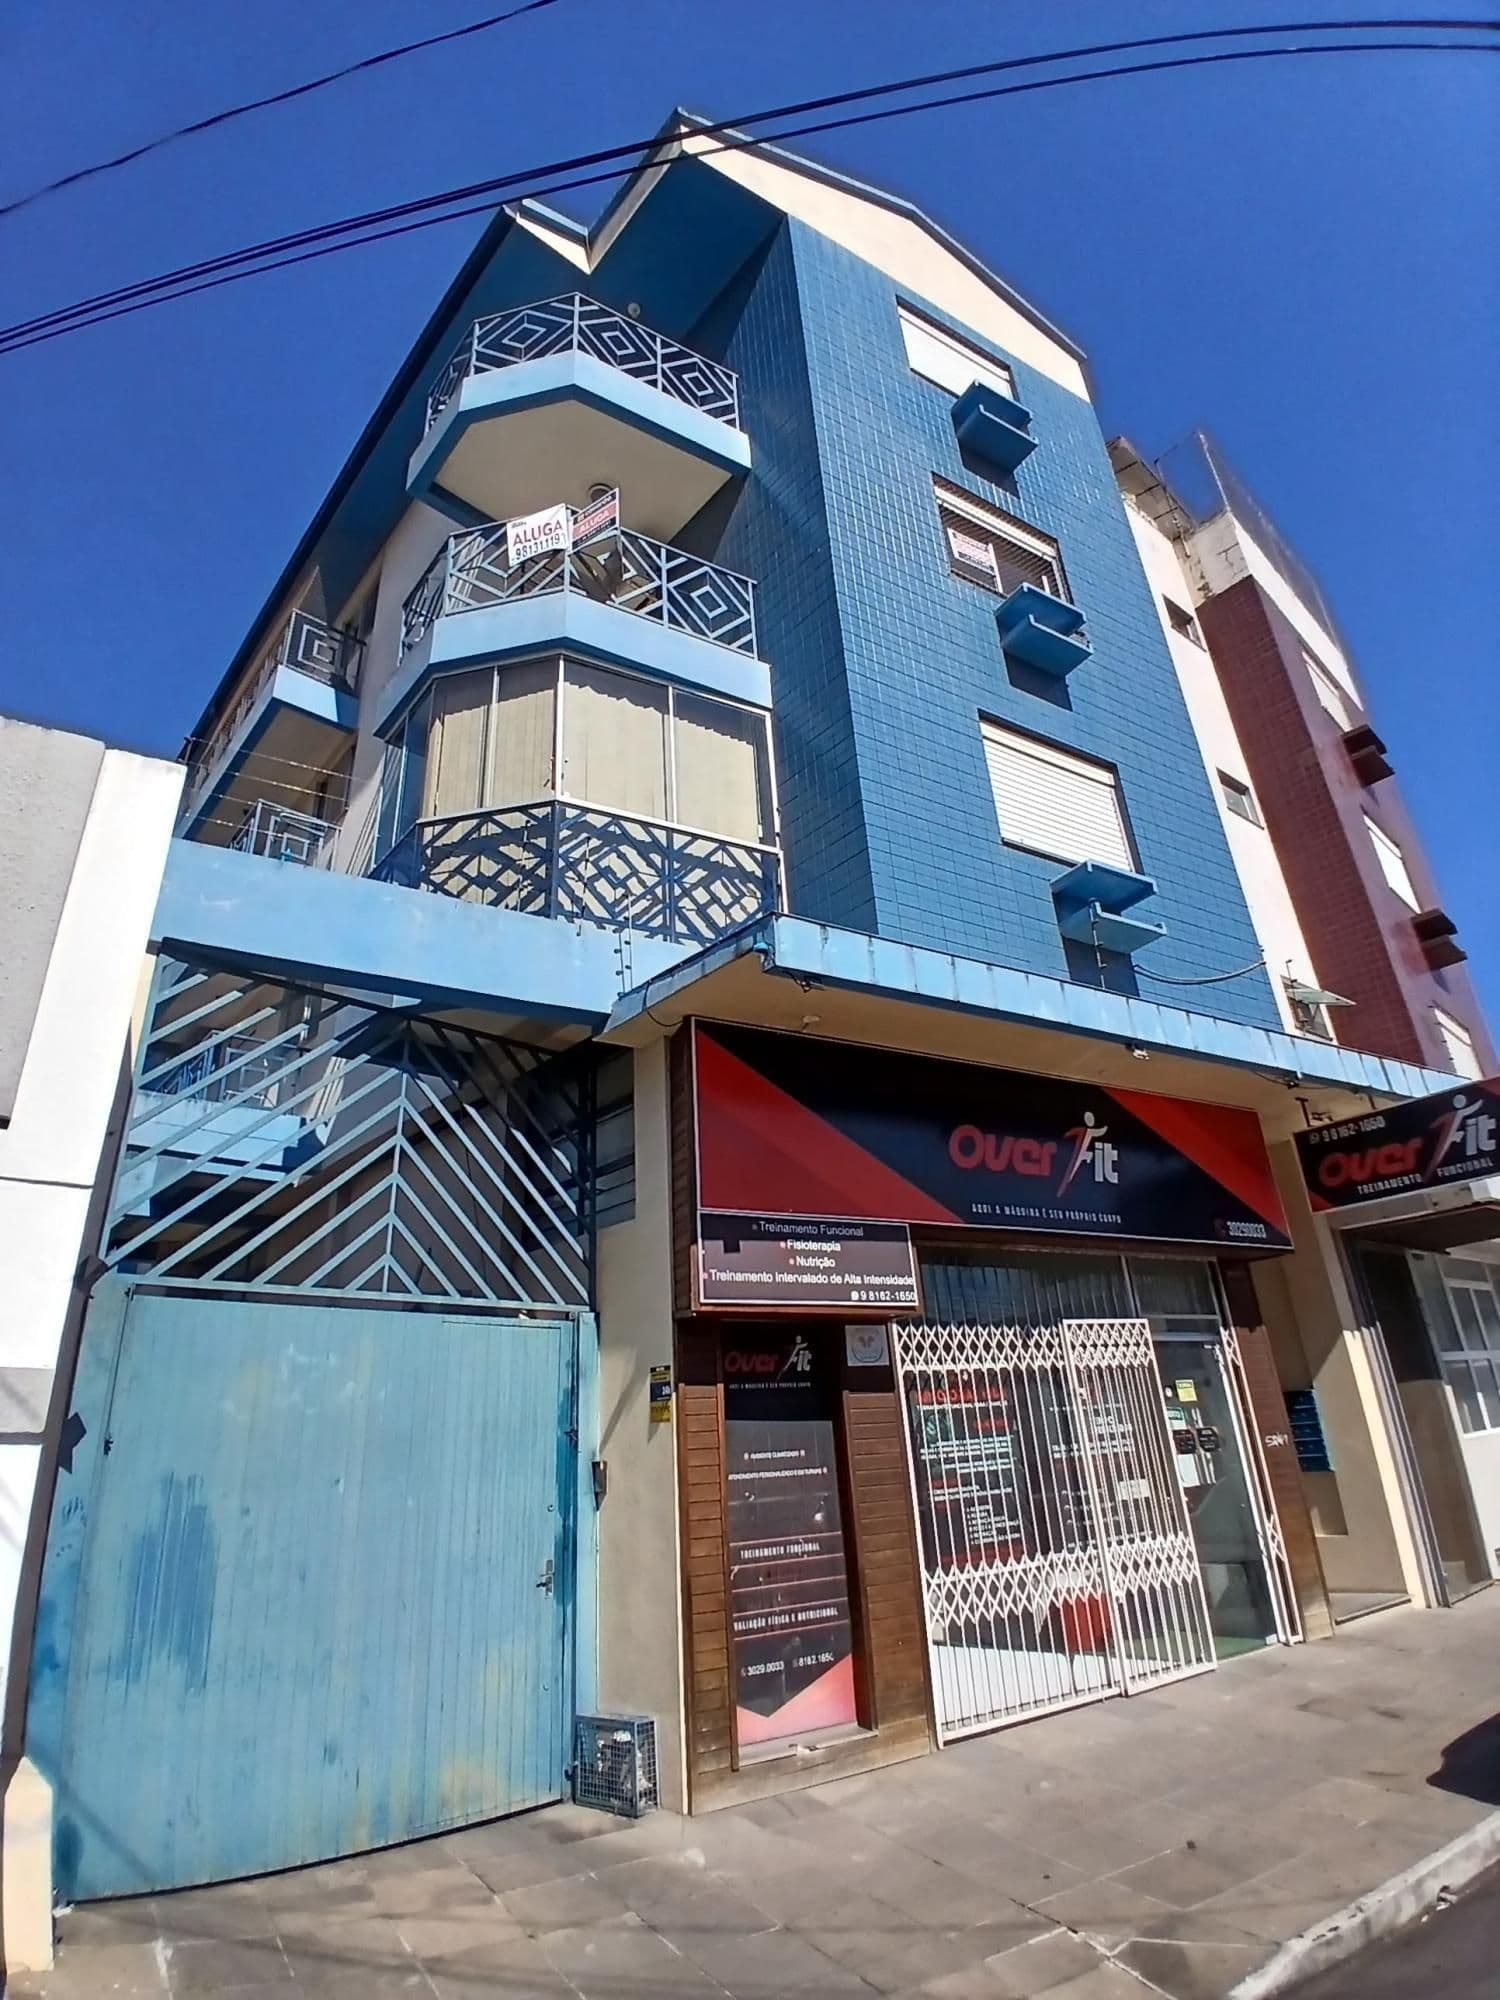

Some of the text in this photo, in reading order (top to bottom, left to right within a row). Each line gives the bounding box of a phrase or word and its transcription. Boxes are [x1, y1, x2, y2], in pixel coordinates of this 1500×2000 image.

[513, 520, 563, 547] ALUGA
[1357, 1157, 1494, 1195] TREINAMENTO FUNCIONAL
[759, 1221, 864, 1237] Treinamento Funcional
[787, 1239, 841, 1252] Fisioterapia
[796, 1257, 836, 1269] Nutrição
[709, 1269, 914, 1286] Treinamento Intervalado de Alta Intensidade
[740, 1544, 784, 1560] TREINAMENTO
